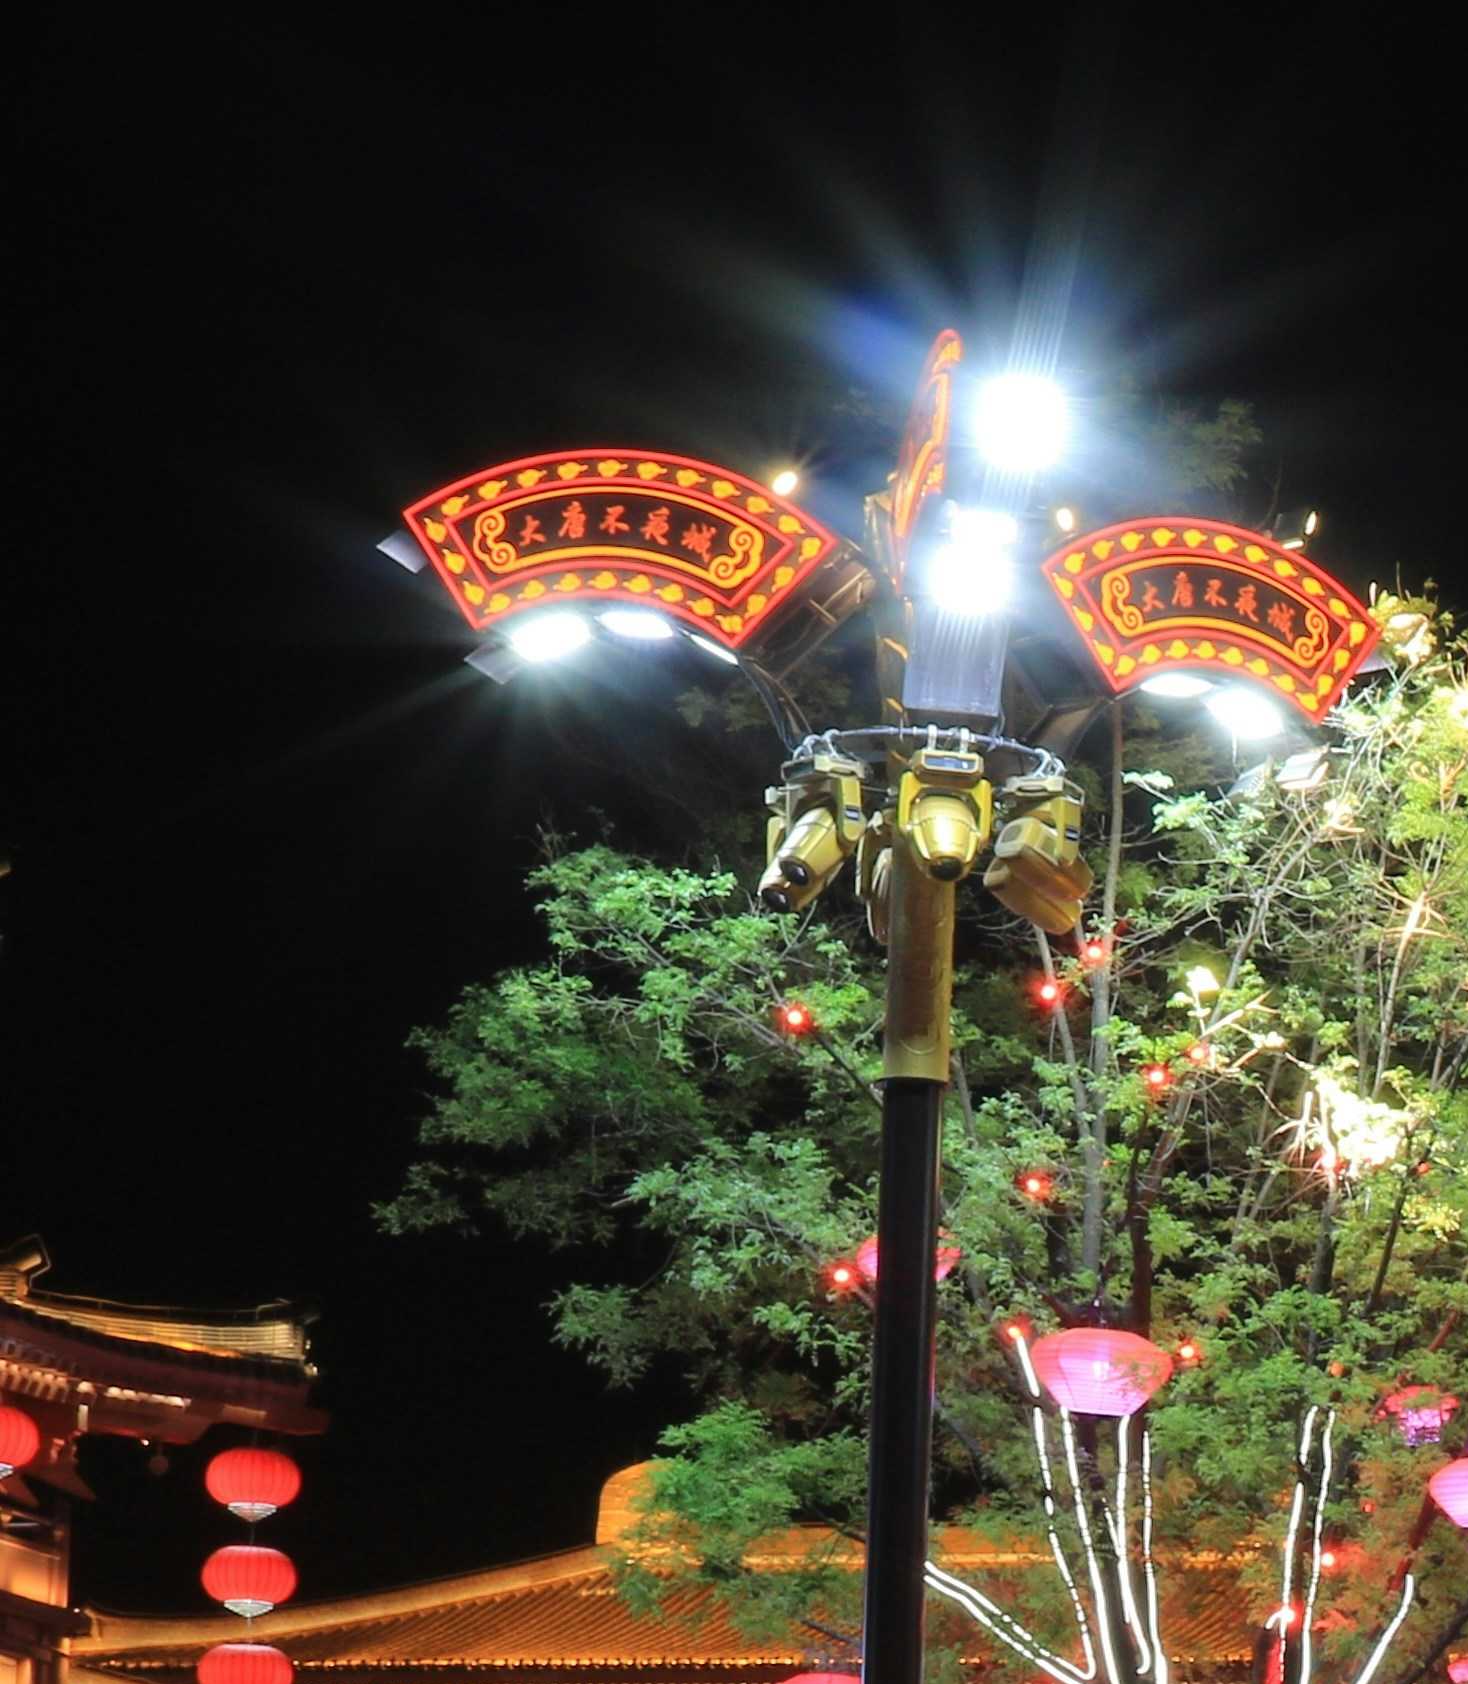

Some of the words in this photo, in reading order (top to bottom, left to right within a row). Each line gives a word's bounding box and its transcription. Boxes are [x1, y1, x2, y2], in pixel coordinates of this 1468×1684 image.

[520, 501, 717, 563] 大唐不夜城
